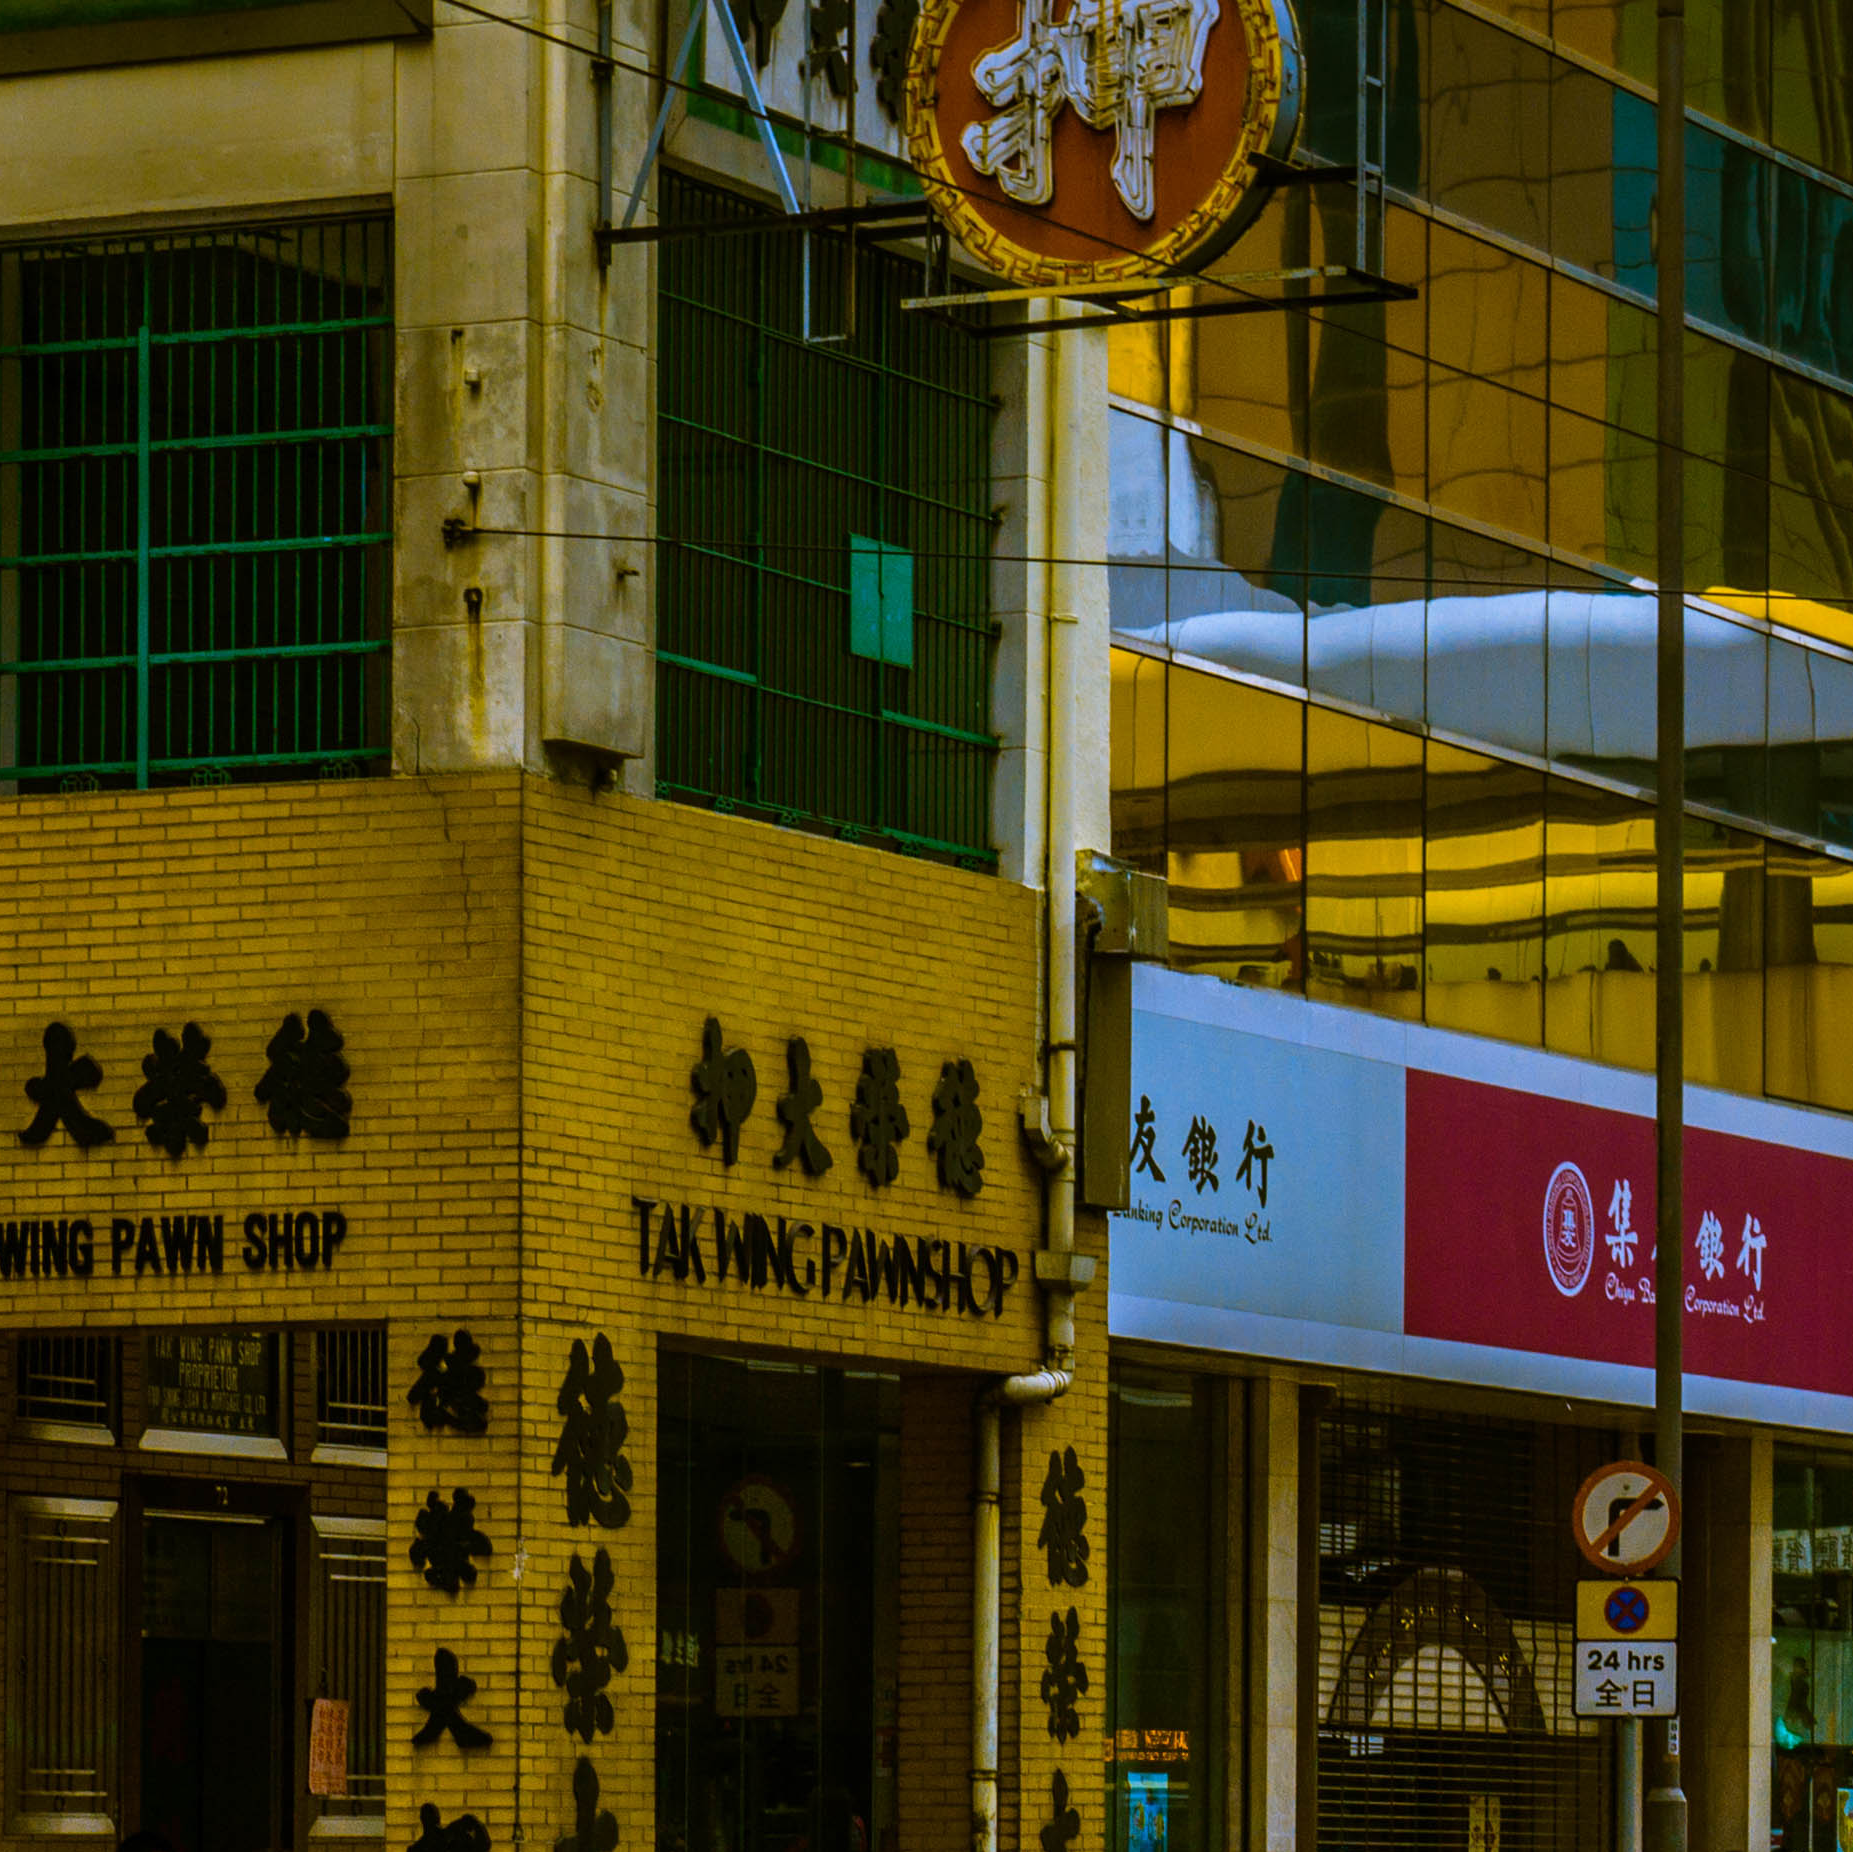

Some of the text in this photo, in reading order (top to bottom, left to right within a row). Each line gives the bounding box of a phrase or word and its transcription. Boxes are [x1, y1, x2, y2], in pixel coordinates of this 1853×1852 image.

[1130, 1094, 1275, 1209] 友銀行
[111, 1213, 225, 1275] PAWN
[242, 1210, 348, 1272] SHOP
[1169, 1199, 1240, 1238] Corporation
[1245, 1212, 1274, 1245] Ltd.
[1604, 1177, 1768, 1293] 集銀行
[631, 1196, 1020, 1319] TAK WING PAWN SHOP
[1684, 1284, 1741, 1318] Corporation
[1743, 1293, 1767, 1325] Ltd.
[1587, 1649, 1666, 1673] 24 hrs
[1595, 1679, 1657, 1711] 全日
